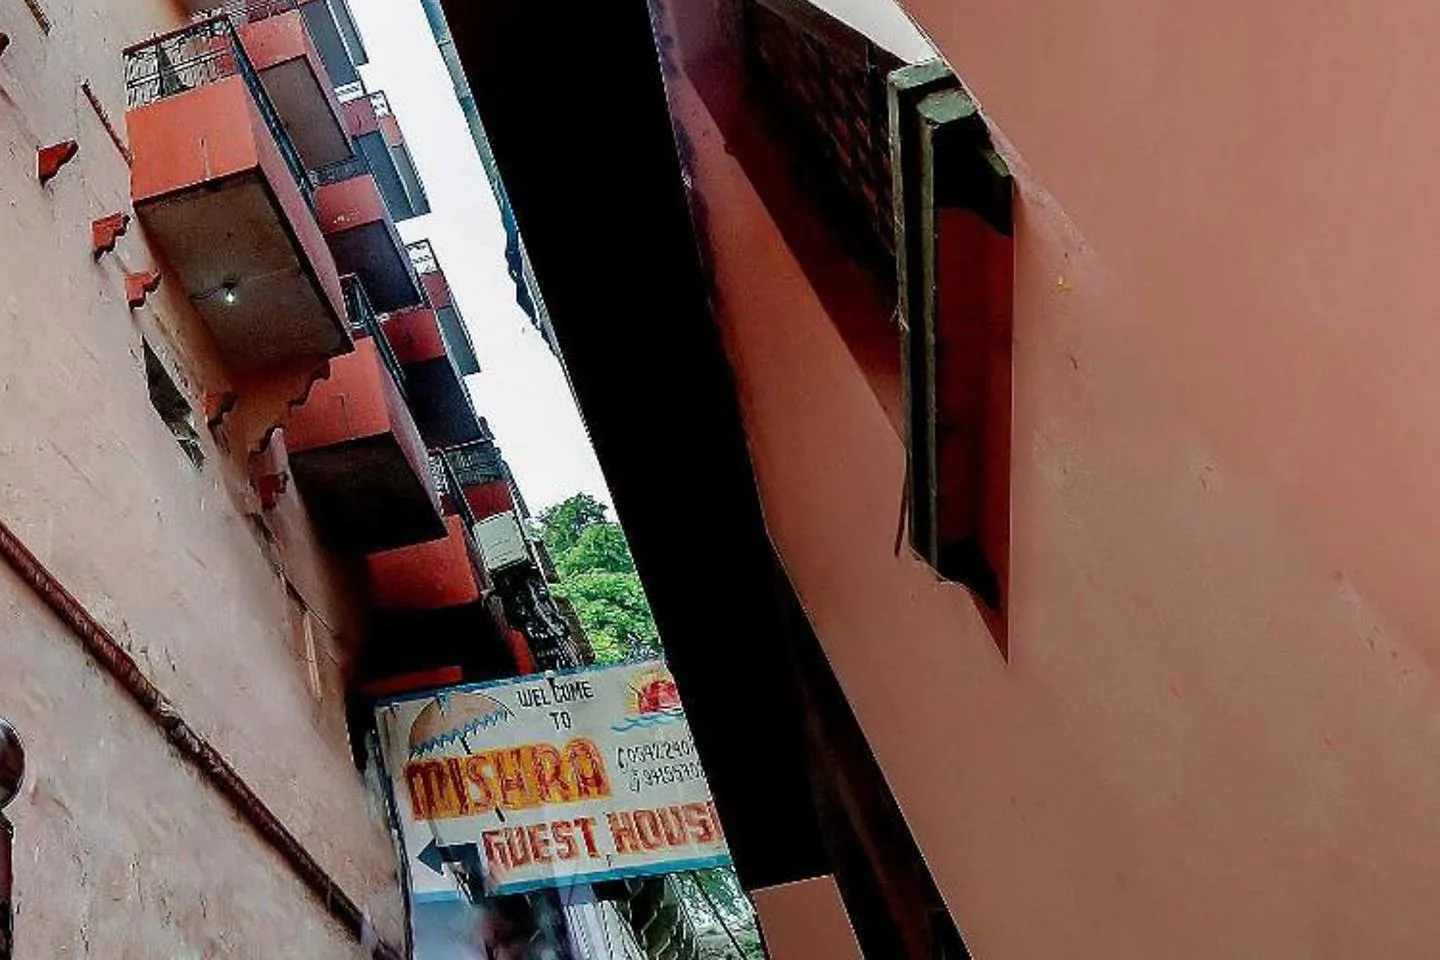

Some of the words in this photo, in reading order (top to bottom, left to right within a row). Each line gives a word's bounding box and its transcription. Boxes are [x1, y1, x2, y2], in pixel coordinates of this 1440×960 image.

[549, 712, 572, 730] TO
[405, 737, 611, 821] MISHRA
[482, 816, 601, 868] GUEST
